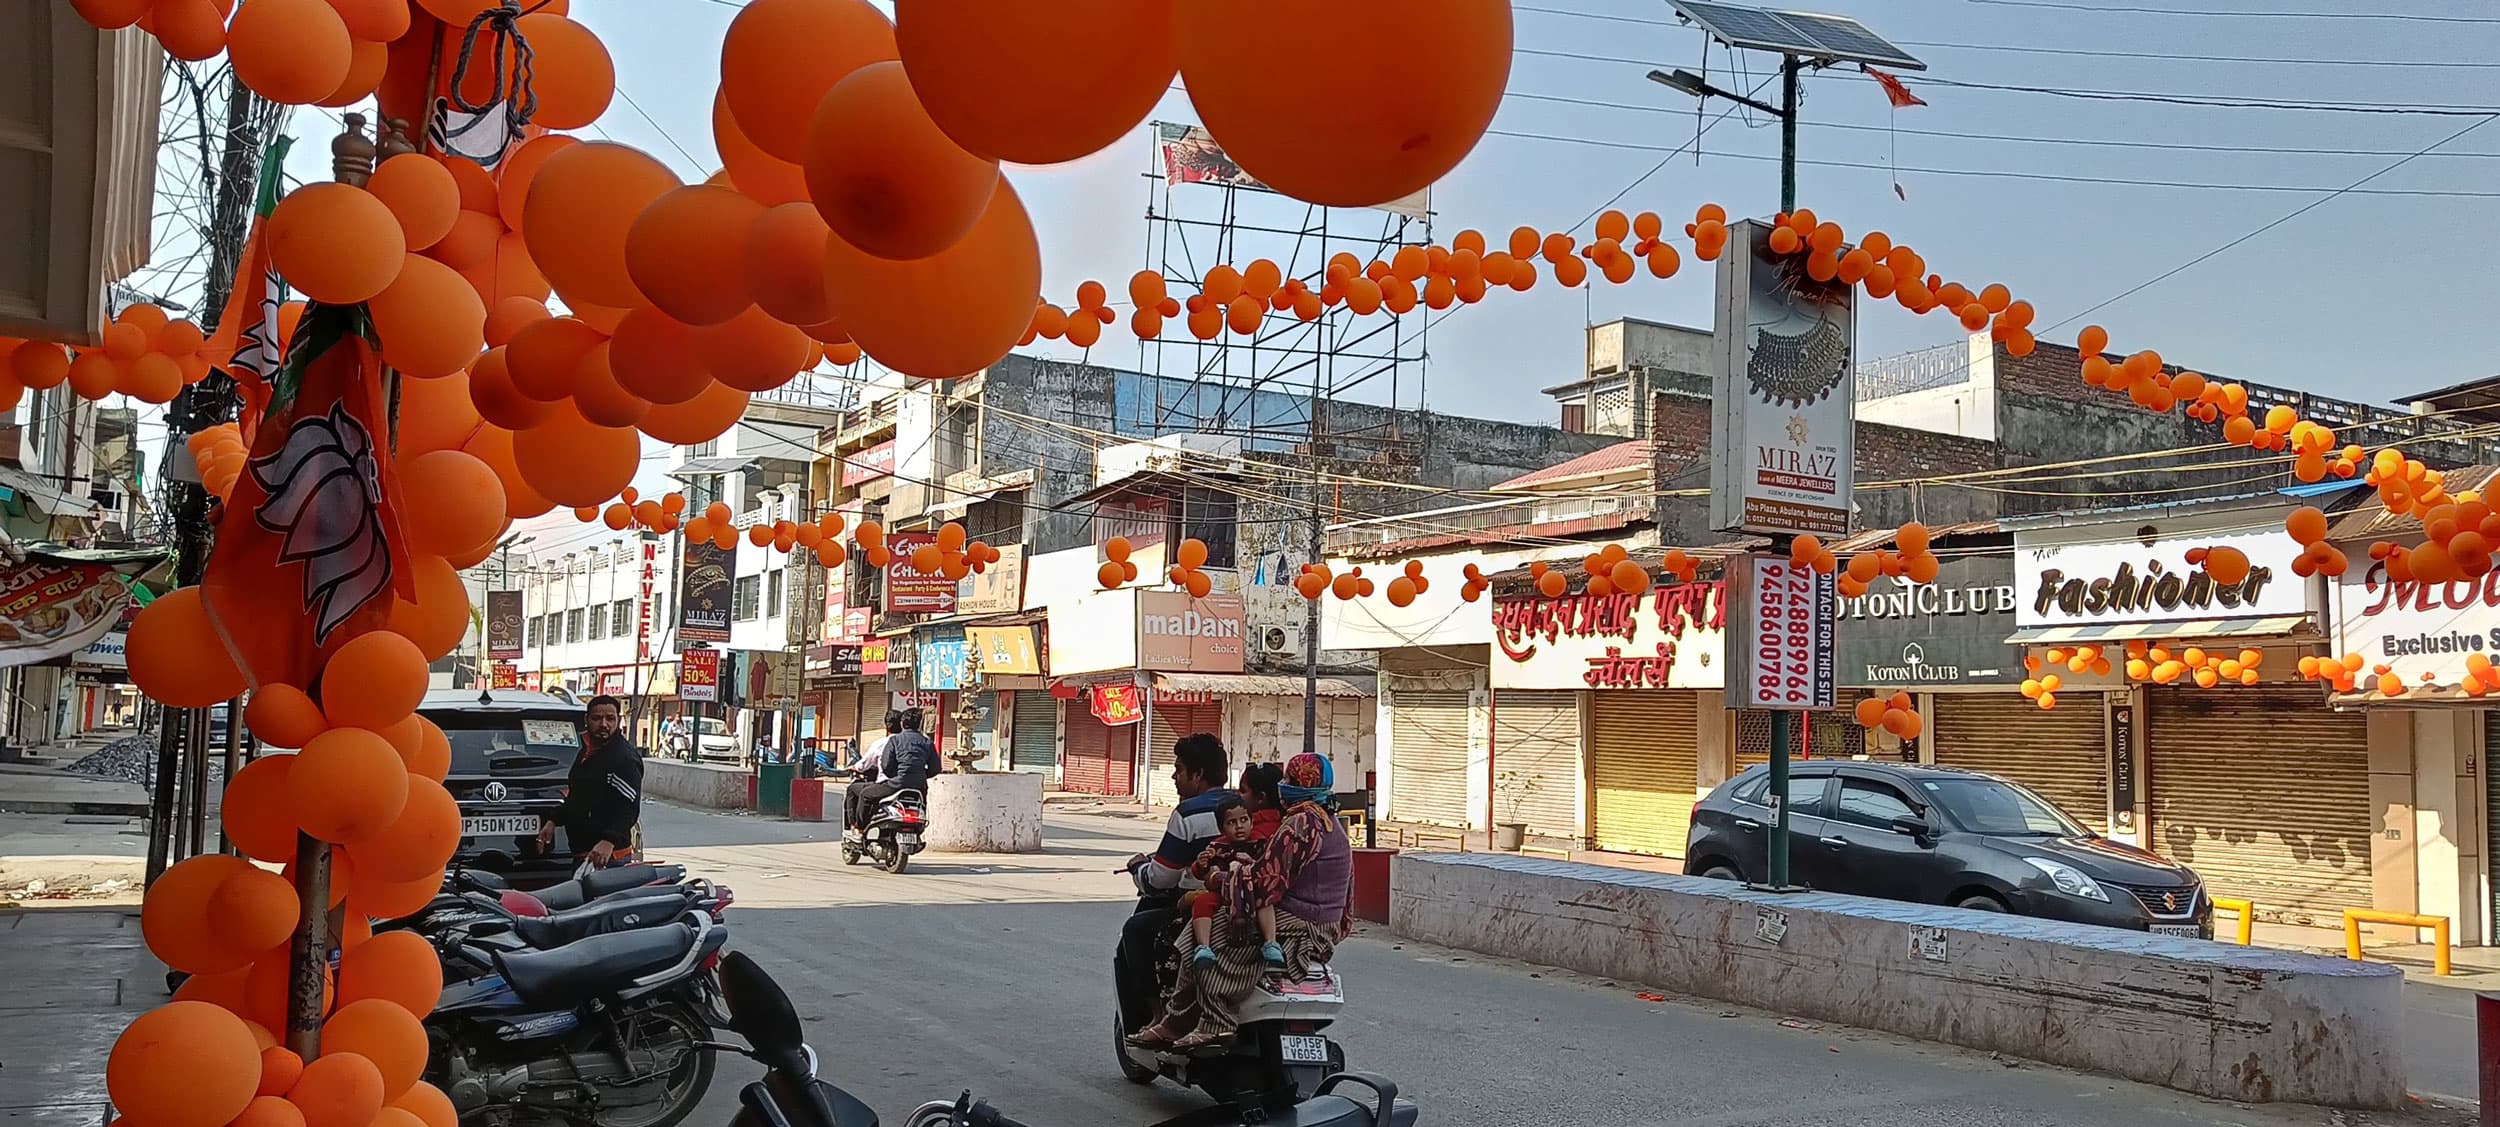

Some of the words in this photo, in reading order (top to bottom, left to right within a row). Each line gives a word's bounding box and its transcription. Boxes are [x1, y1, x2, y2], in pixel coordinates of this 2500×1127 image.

[1758, 446, 1836, 478] MIRA'Z
[1776, 475, 1797, 486] MEERA
[1799, 478, 1834, 491] JEWELLERS
[1746, 502, 1758, 511] Abu
[1760, 503, 1779, 515] Plaza,
[1807, 509, 1828, 520] Meerut
[638, 543, 656, 658] NAVEEN
[1819, 572, 1832, 621] ONTACH
[1917, 583, 2017, 614] CLUB
[2034, 559, 2273, 618] Fashioner
[1144, 610, 1239, 638] maDam
[1758, 565, 1783, 701] 9458600786
[1786, 567, 1810, 702] 7248889966
[1819, 624, 1832, 647] FOR
[1210, 643, 1238, 655] choice
[2382, 631, 2484, 657] Exclusive
[685, 657, 715, 666] SALE
[1145, 655, 1170, 664] Ladies
[1172, 655, 1193, 665] Wear
[1818, 650, 1831, 678] THIS
[1866, 664, 1910, 681] KOTON
[1918, 663, 1959, 681] CLUB
[684, 670, 710, 684] 50%
[1818, 681, 1831, 708] SITE
[2118, 726, 2128, 760] KOTON
[2118, 762, 2128, 791] CLUB
[1290, 1048, 1323, 1060] V6053
